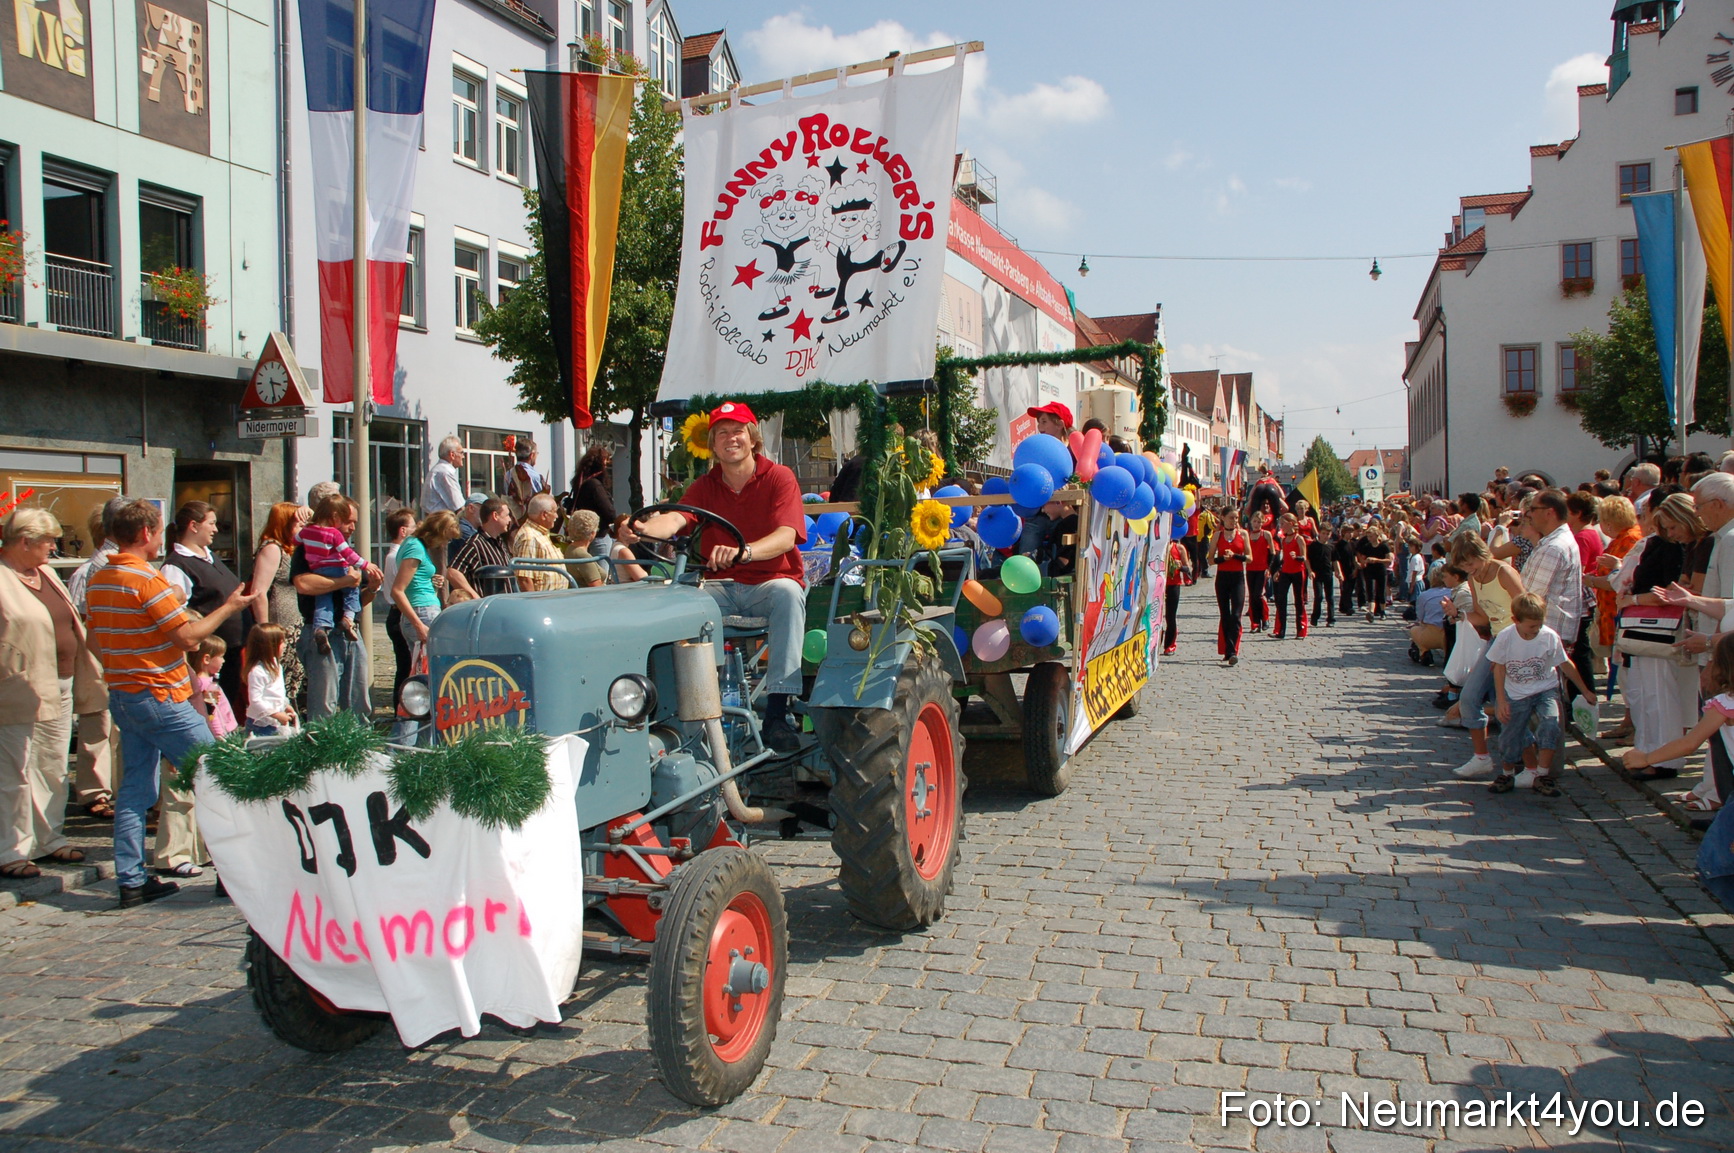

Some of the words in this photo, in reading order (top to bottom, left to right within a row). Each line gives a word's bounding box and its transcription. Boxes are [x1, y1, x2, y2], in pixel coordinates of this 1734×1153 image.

[700, 131, 798, 251] FUNNY
[948, 218, 975, 252] arkasse
[785, 347, 820, 378] DJK
[828, 289, 905, 358] Neumarkt
[246, 420, 298, 433] Nidermayer
[435, 689, 531, 731] Eicher
